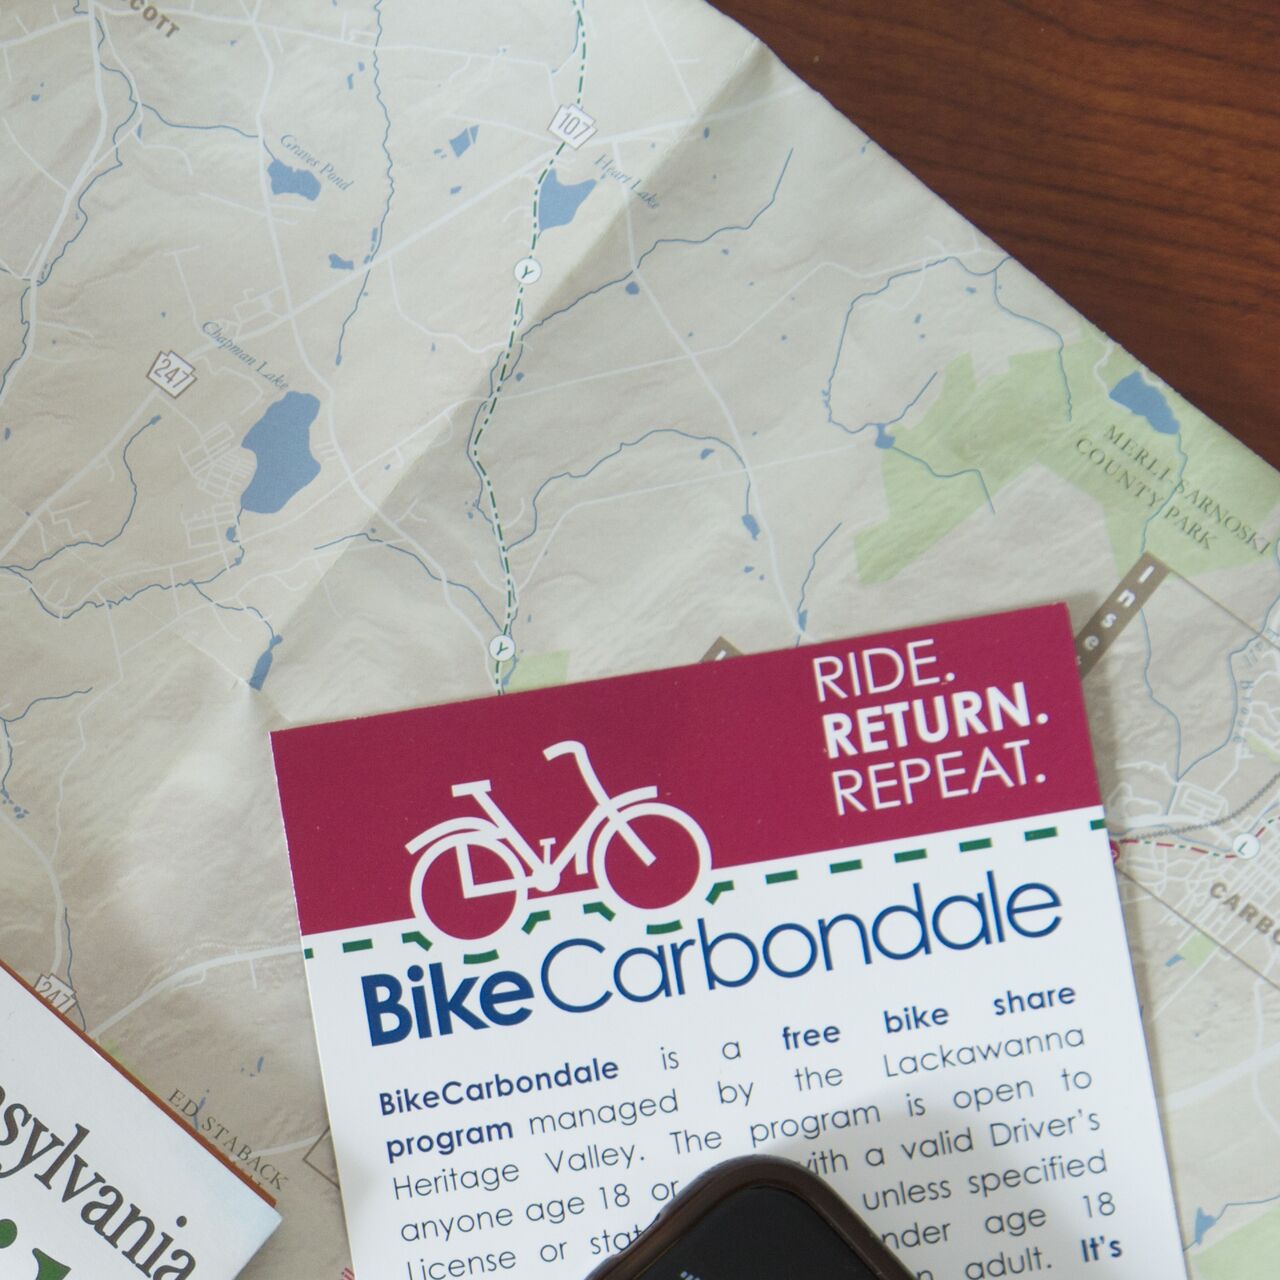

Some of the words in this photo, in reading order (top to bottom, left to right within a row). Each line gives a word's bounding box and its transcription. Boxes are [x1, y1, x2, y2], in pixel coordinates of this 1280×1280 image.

[557, 112, 591, 140] 107
[320, 162, 354, 191] Pond
[594, 154, 632, 184] Heart
[630, 179, 660, 209] Lake
[154, 358, 190, 389] 247
[201, 321, 257, 366] Chapman
[255, 360, 289, 391] Lake
[1075, 437, 1164, 508] COUNTY
[1164, 505, 1218, 551] PARK
[813, 638, 956, 703] RIDE.
[822, 682, 1050, 759] RETURN.
[829, 738, 1048, 817] REPEAT.
[359, 869, 1063, 1047] BikeCarbondale
[380, 1058, 618, 1115] BikeCarbondale
[660, 1047, 679, 1070] is
[722, 1042, 741, 1060] a
[782, 1026, 840, 1050] free
[884, 1006, 949, 1033] bike
[994, 987, 1075, 1016] share
[387, 1122, 513, 1164] program
[529, 1088, 678, 1135] managed
[717, 1081, 753, 1106] by
[794, 1067, 843, 1091] the
[884, 1029, 1084, 1077] Lackawanna
[393, 1164, 519, 1200] Heritage
[545, 1144, 644, 1173] Valley.
[669, 1130, 721, 1154] The
[750, 1105, 880, 1148] program
[906, 1093, 925, 1117] is
[953, 1081, 1033, 1112] open
[1061, 1068, 1092, 1091] to
[167, 1087, 199, 1120] ED
[200, 1114, 289, 1193] STABACK
[401, 1209, 513, 1241] anyone
[526, 1197, 584, 1224] age
[599, 1184, 630, 1209] 18
[651, 1180, 679, 1201] or
[865, 1148, 885, 1166] a
[901, 1127, 973, 1159] valid
[990, 1109, 1100, 1147] Driver's
[540, 1242, 567, 1262] or
[863, 1180, 951, 1210] unless
[968, 1149, 1107, 1197] specified
[985, 1209, 1046, 1237] age
[1083, 1192, 1115, 1218] 18
[965, 1247, 1052, 1280] adult.
[1081, 1236, 1122, 1262] It's
